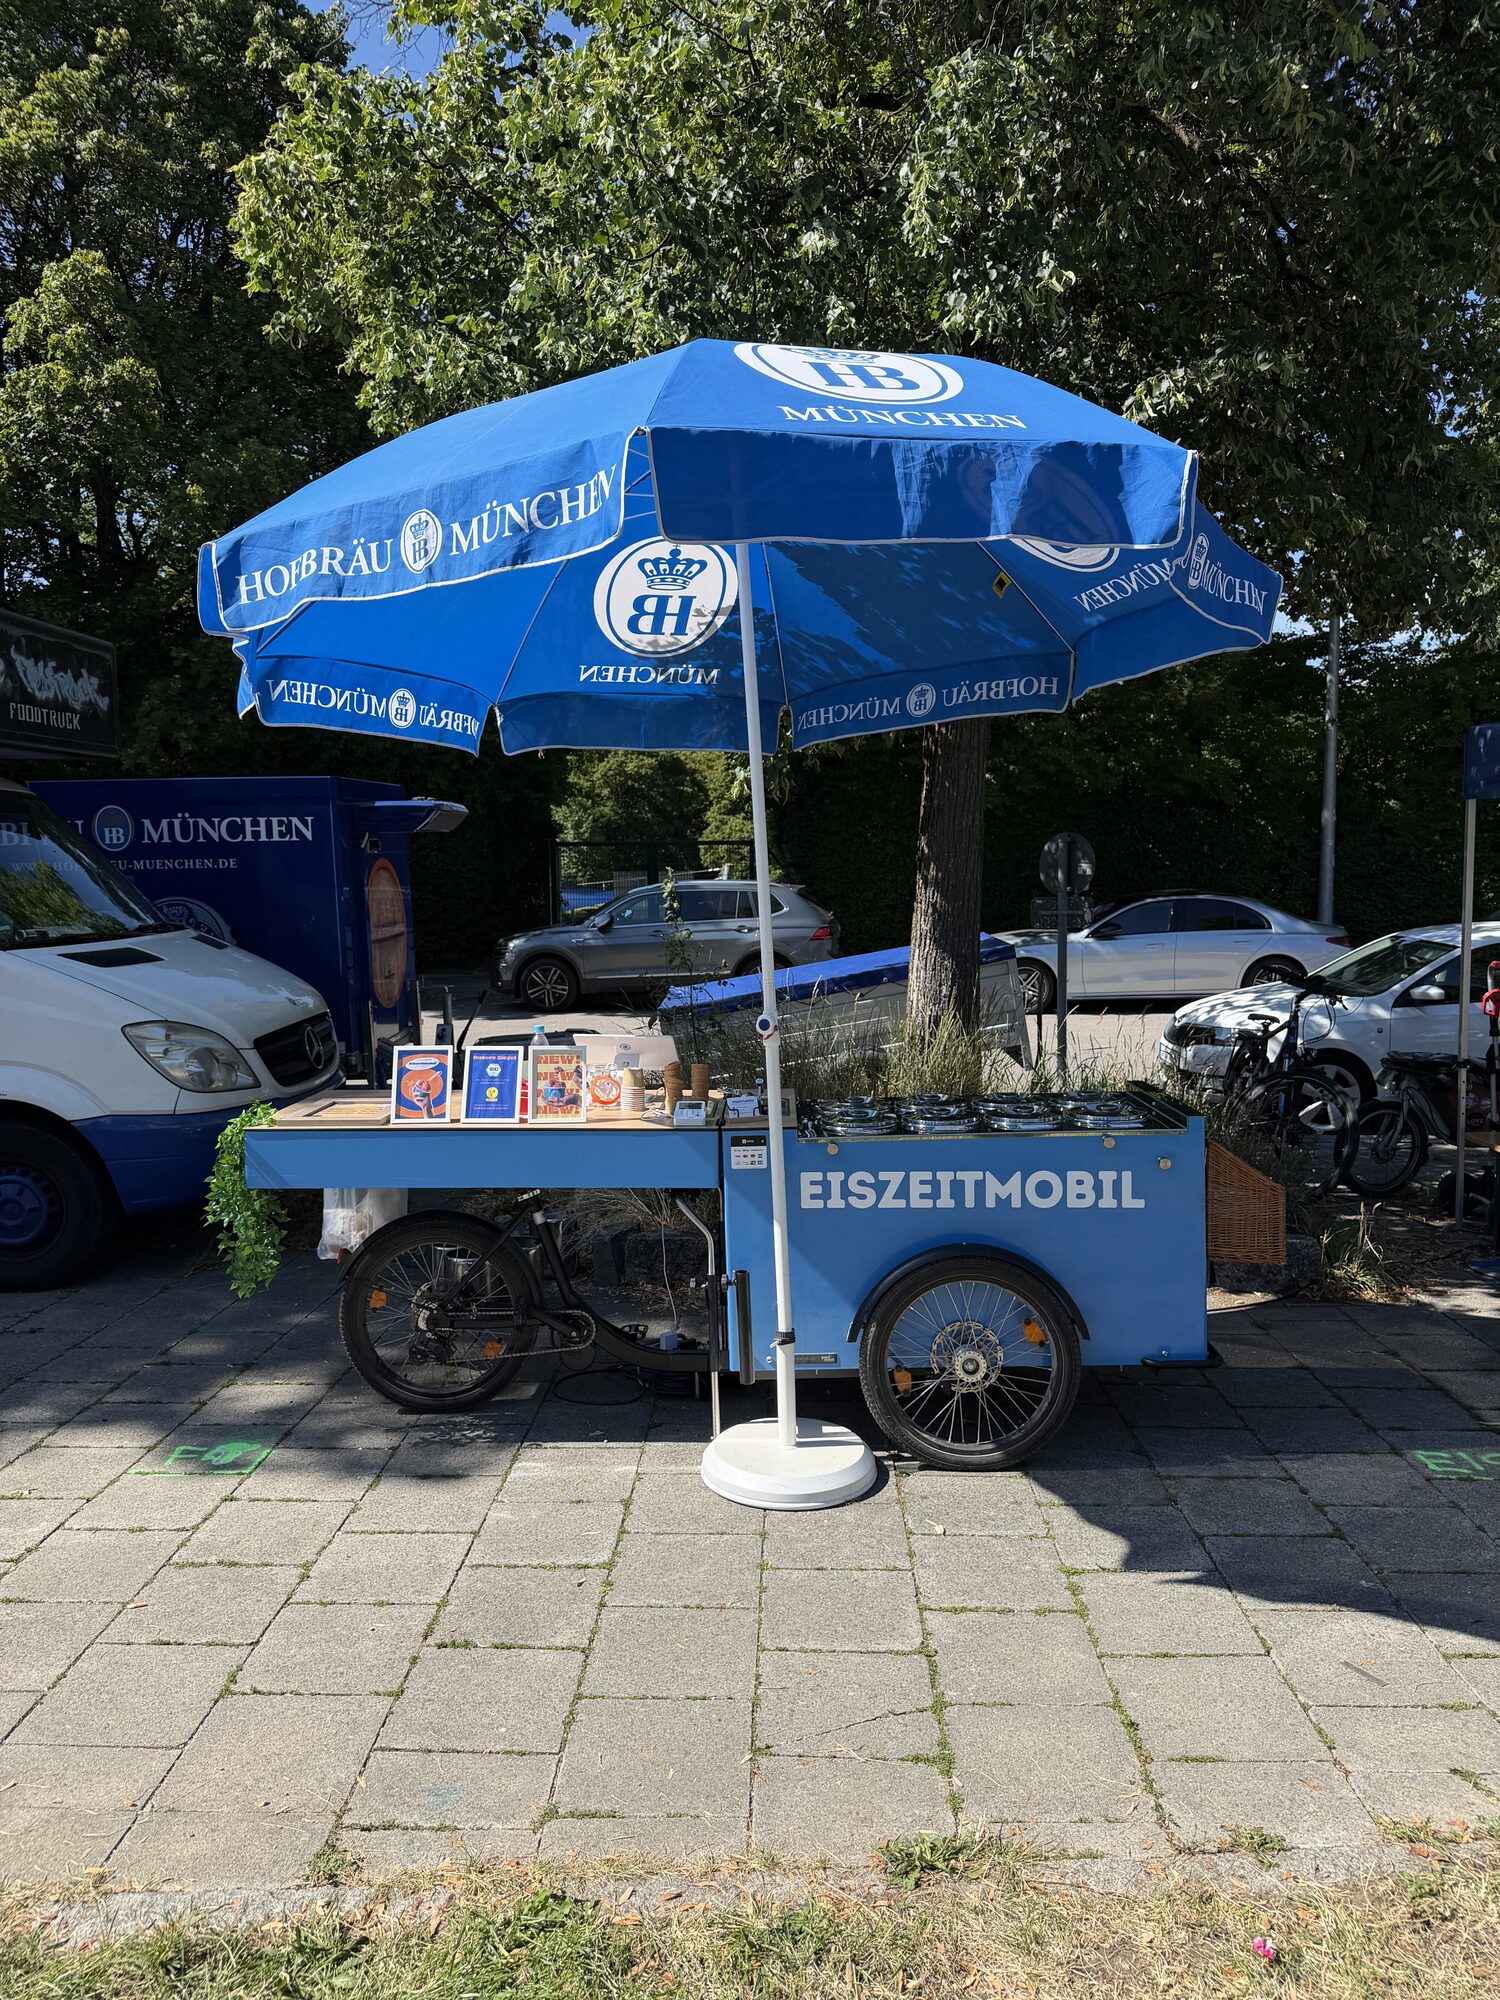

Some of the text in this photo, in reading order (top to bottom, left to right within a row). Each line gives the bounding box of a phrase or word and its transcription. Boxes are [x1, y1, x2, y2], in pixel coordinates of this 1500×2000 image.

[802, 361, 920, 391] HB
[777, 405, 1027, 429] MÜNCHEN
[236, 464, 617, 604] HOFBRÄU HB MÜNCHEN
[9, 702, 81, 730] FOODTRUCK
[103, 827, 125, 844] HB
[141, 812, 314, 844] MÜNCHEN
[536, 1055, 581, 1065] NEW!
[536, 1071, 575, 1081] NEW
[536, 1105, 580, 1115] NEW!
[800, 1170, 1145, 1209] EISZEITMOBIL
